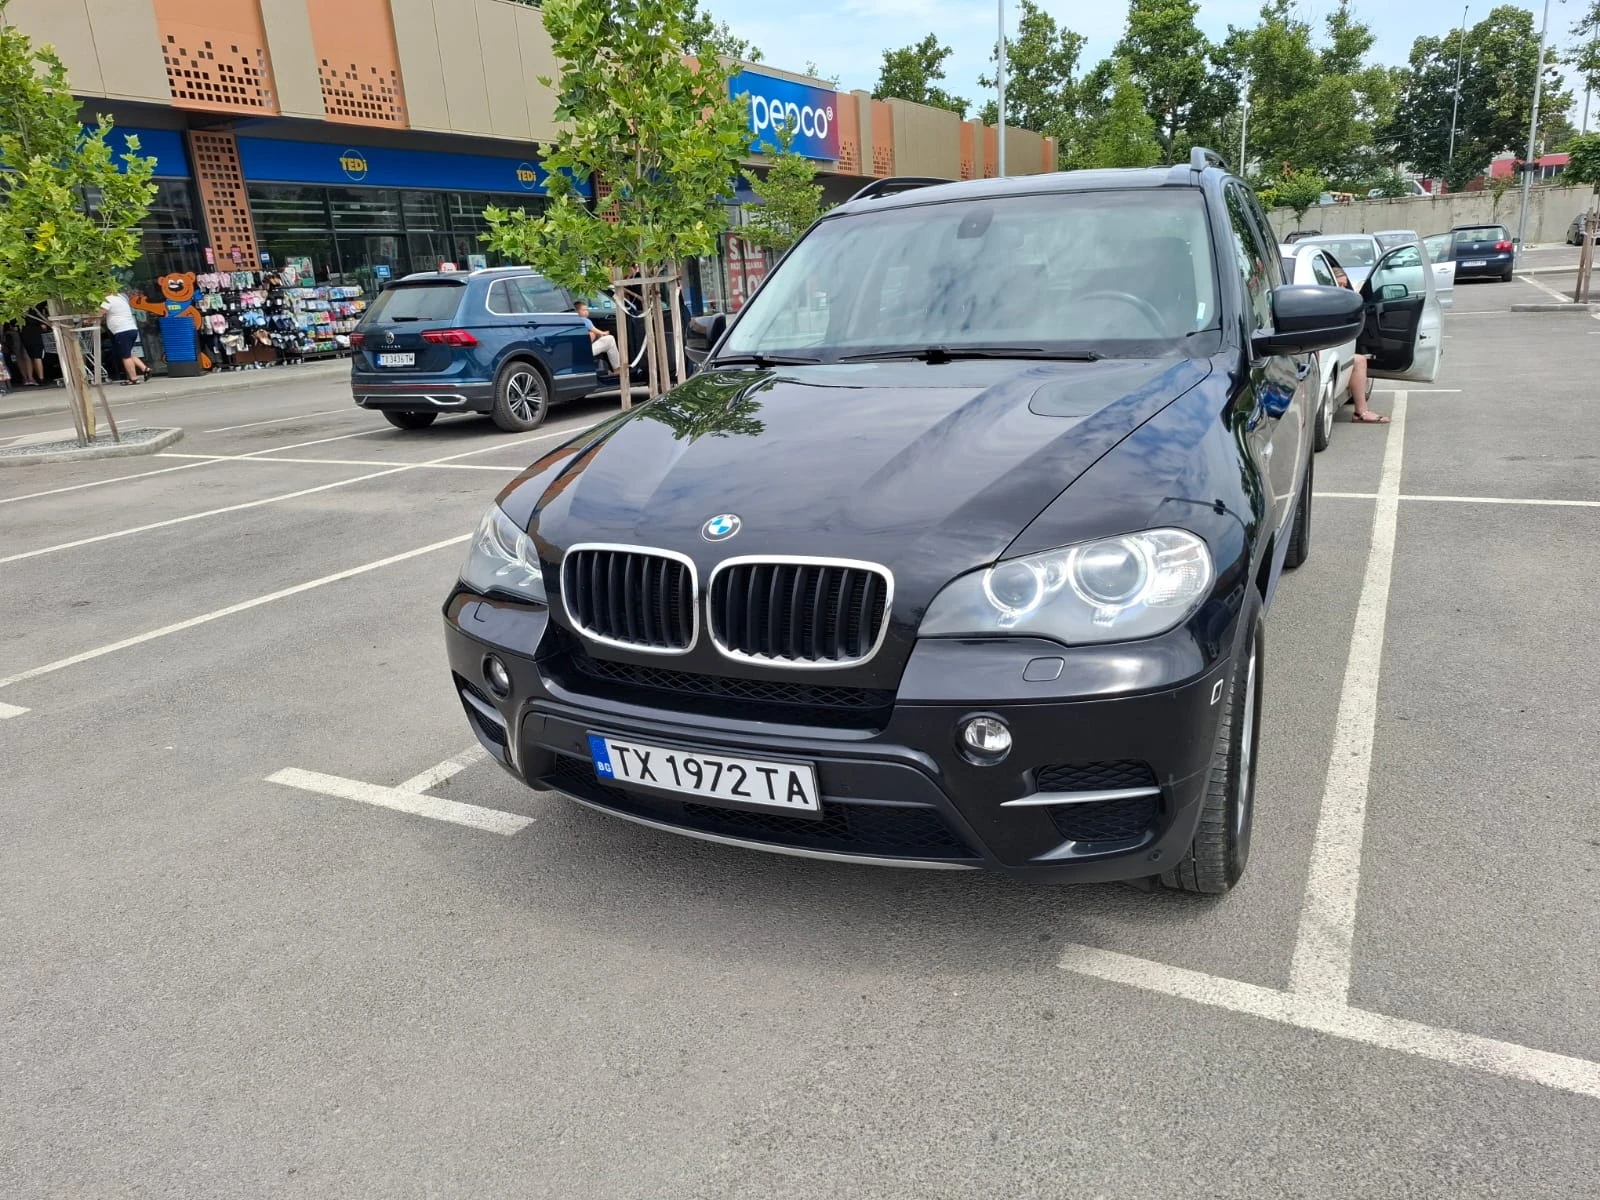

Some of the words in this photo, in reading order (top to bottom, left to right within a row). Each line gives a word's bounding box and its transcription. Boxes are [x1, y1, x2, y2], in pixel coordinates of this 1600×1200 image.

[339, 157, 367, 171] TEDi
[516, 169, 536, 181] TEDi
[597, 761, 612, 773] BG
[611, 744, 658, 782] TX
[665, 755, 751, 797] 1972
[755, 766, 809, 805] TA
